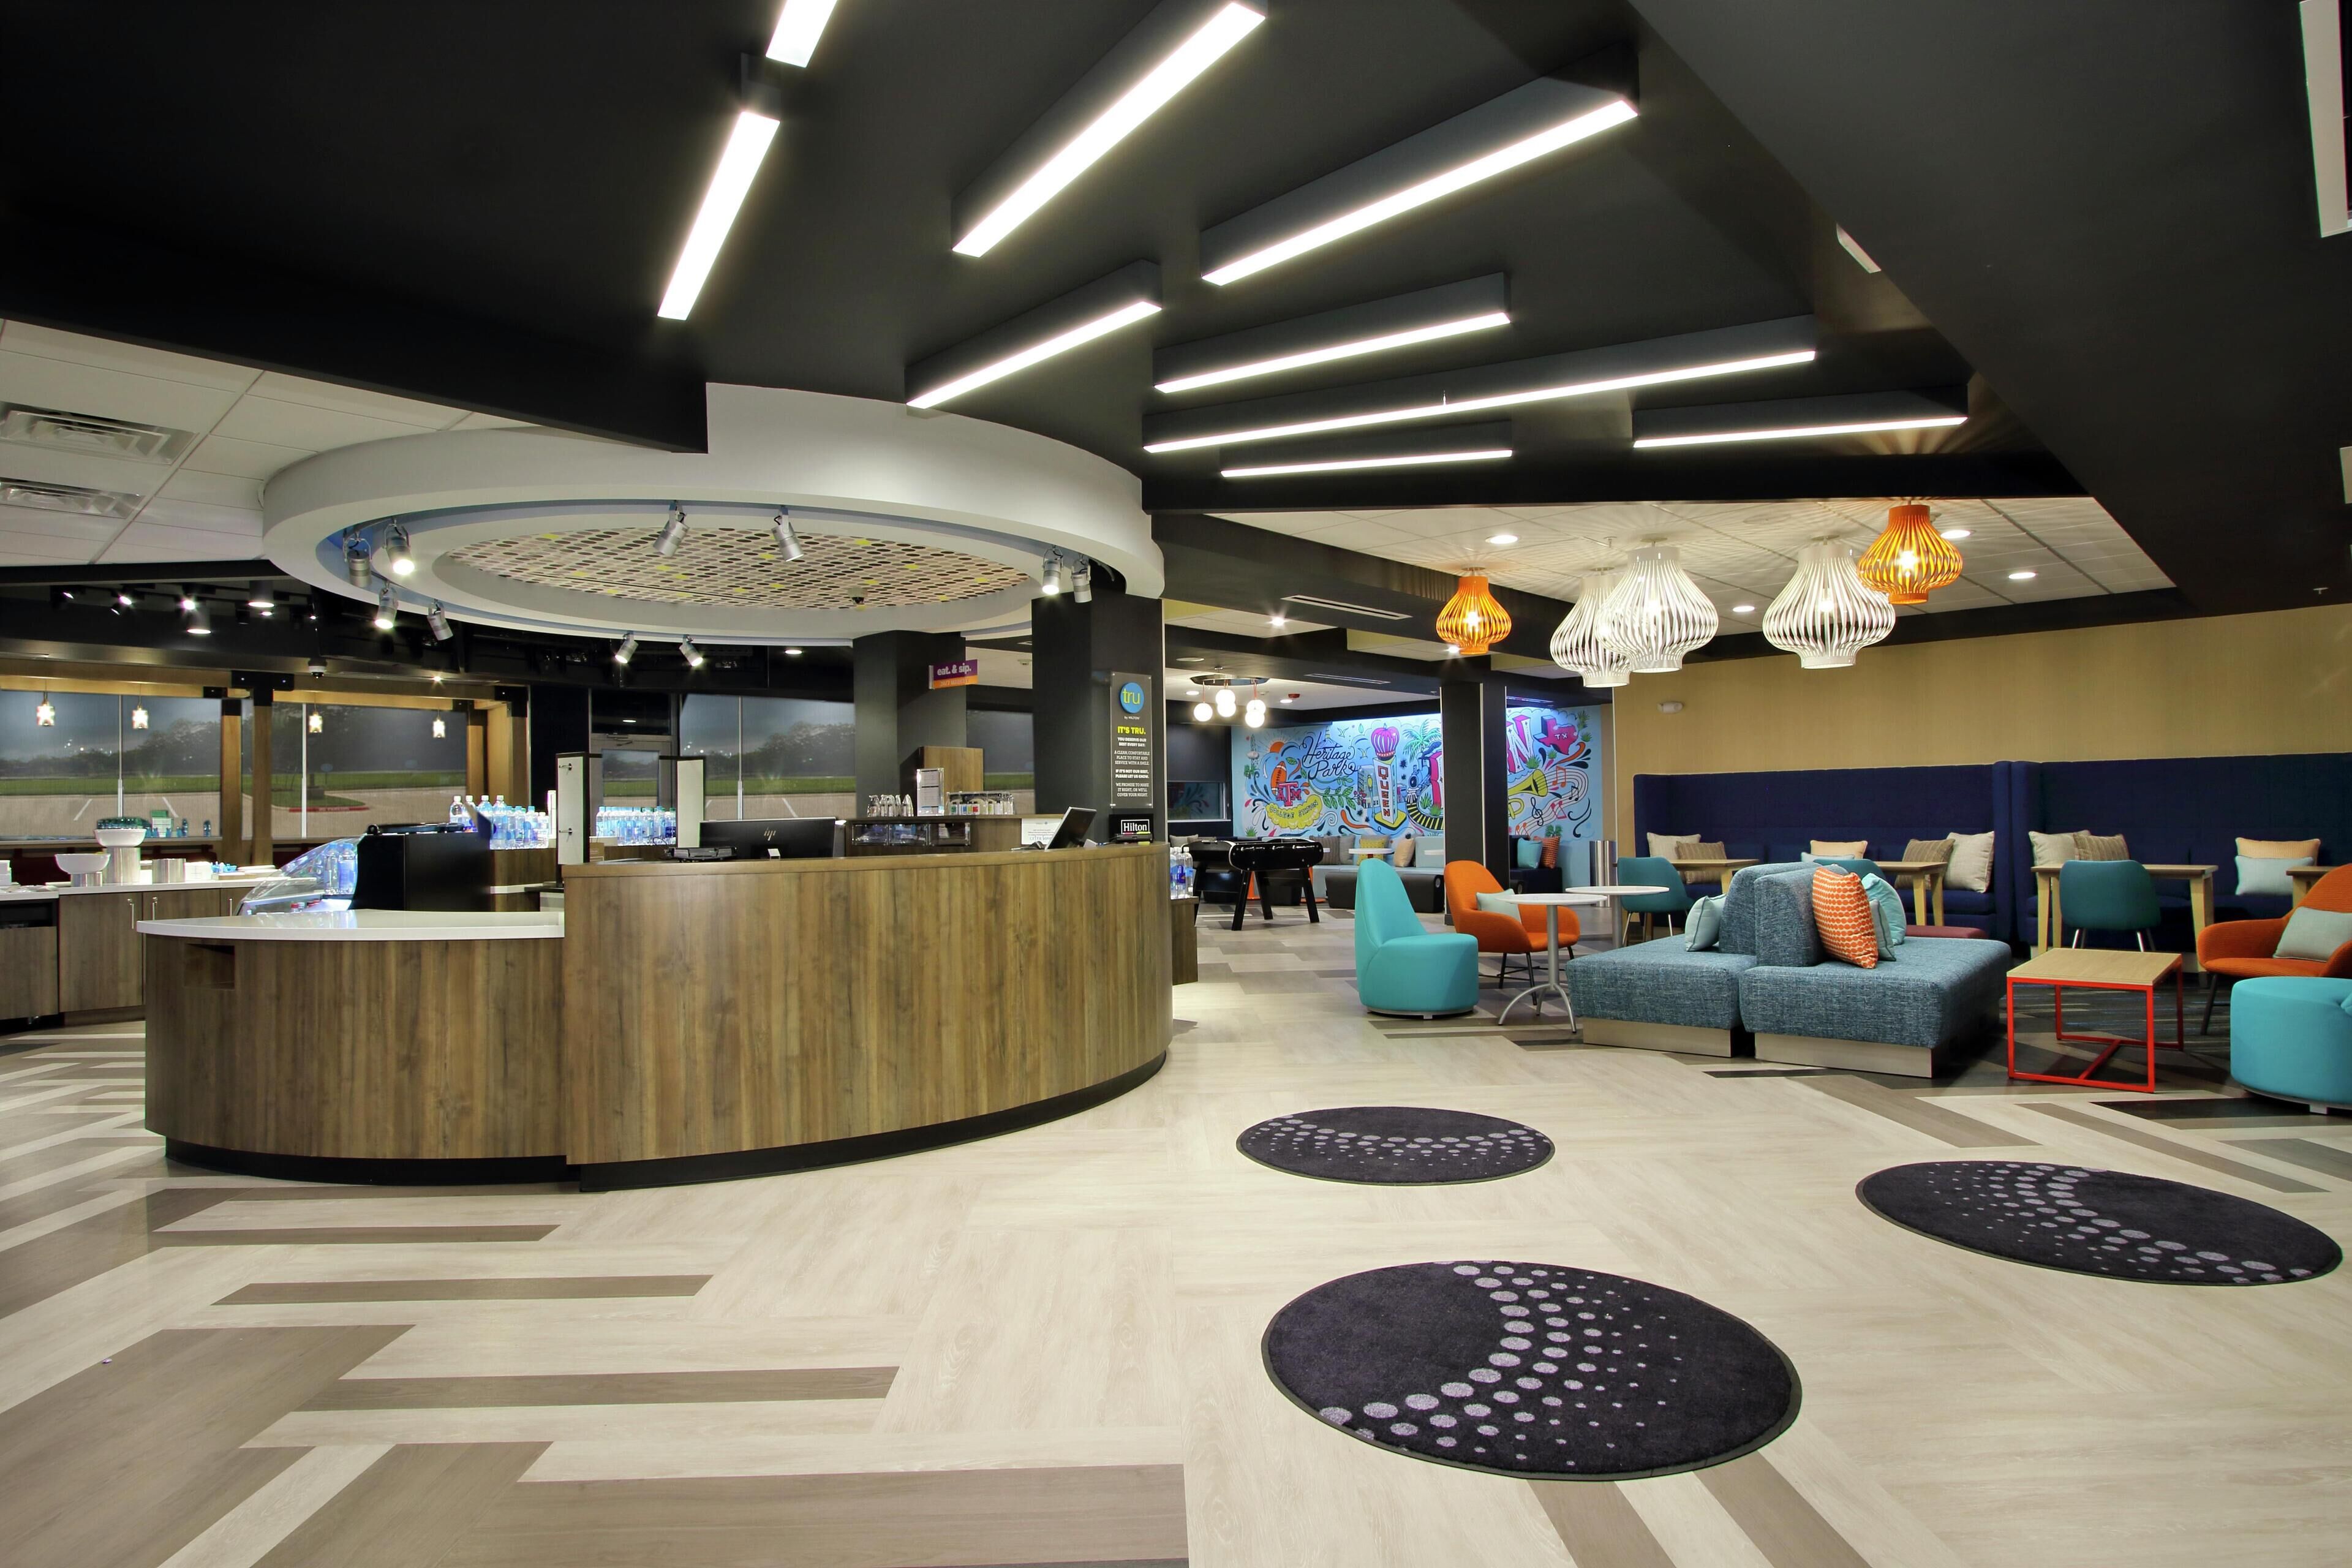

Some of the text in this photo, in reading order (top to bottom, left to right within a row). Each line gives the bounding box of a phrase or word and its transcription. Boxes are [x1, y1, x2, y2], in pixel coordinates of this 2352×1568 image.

[937, 663, 971, 675] eat. & sip.
[1123, 688, 1140, 704] tru
[1301, 732, 1354, 764] Heritage
[1307, 760, 1357, 780] Park
[1378, 765, 1390, 817] QUEEN
[1269, 799, 1318, 818] COLLEGE STATION
[1123, 822, 1147, 832] Hilton
